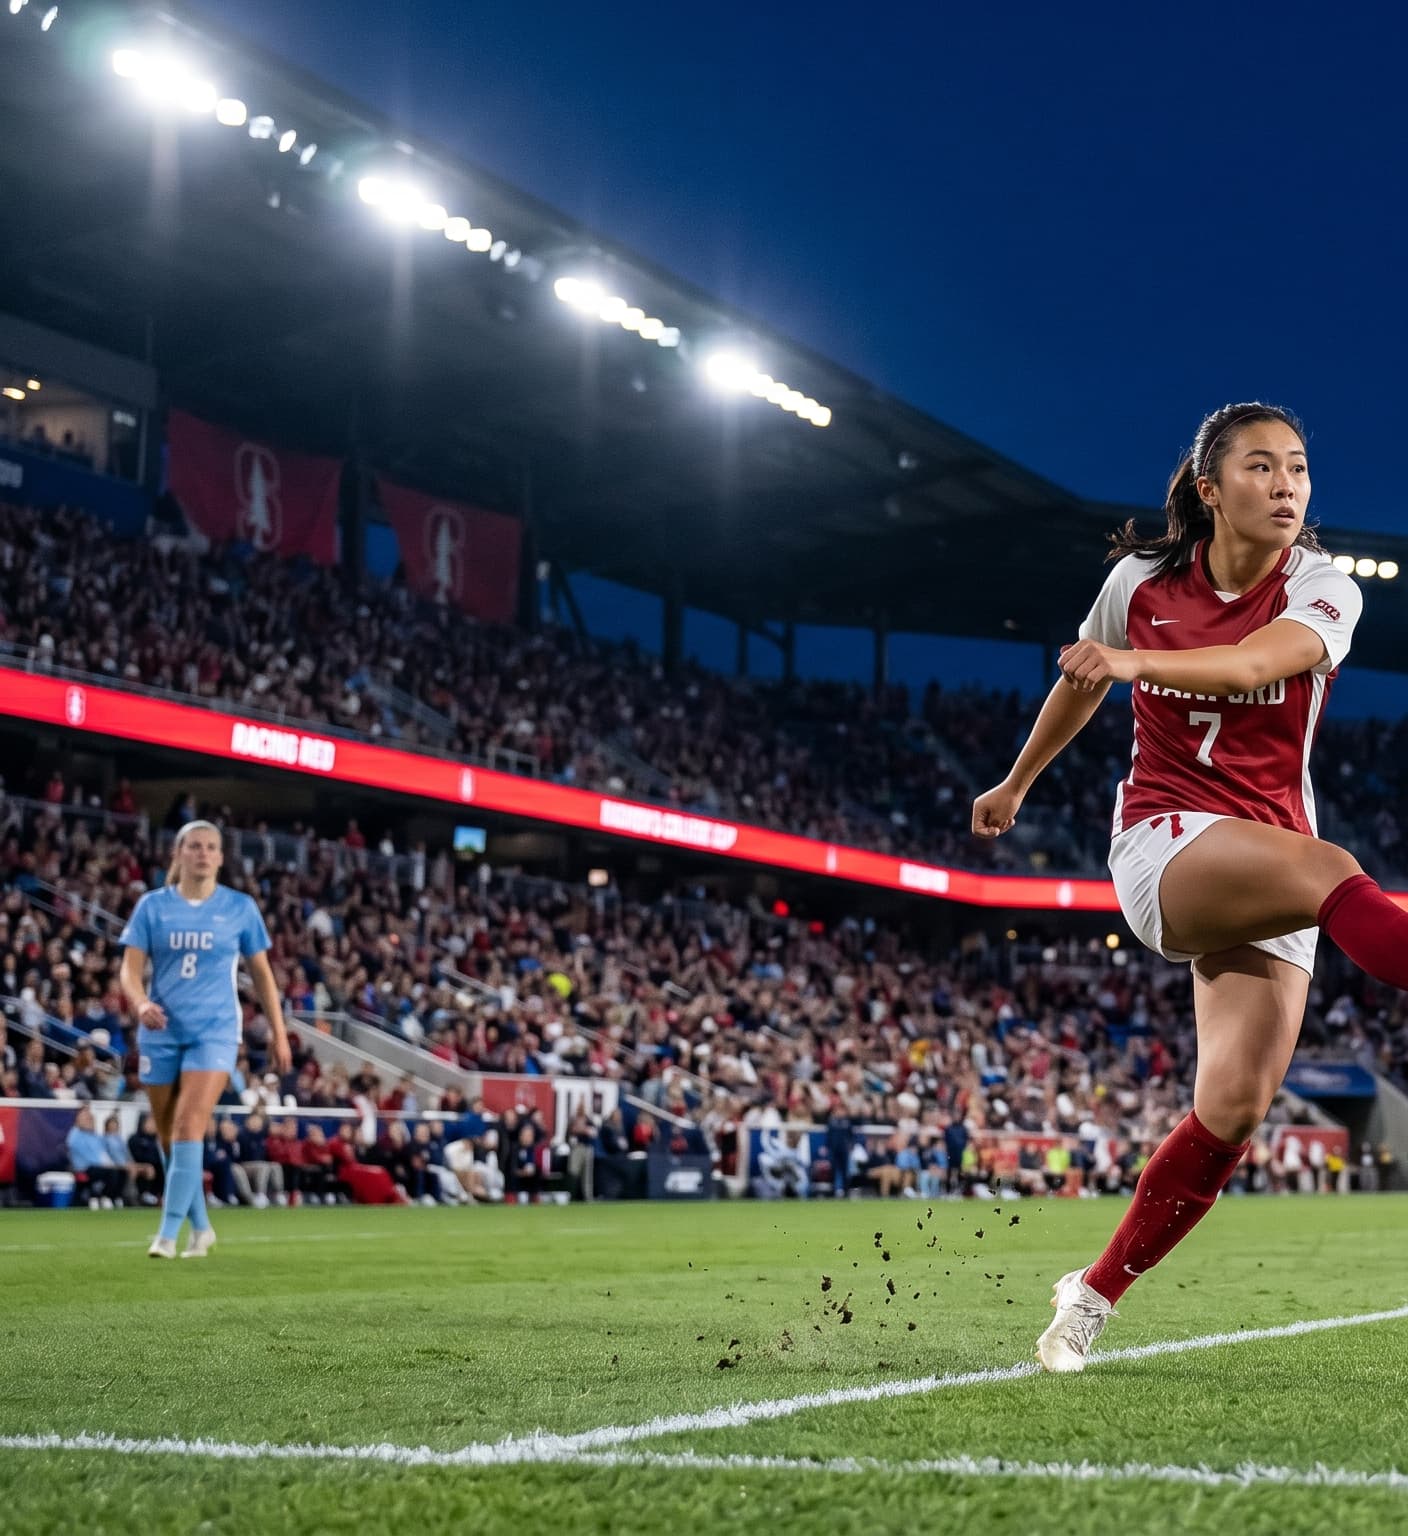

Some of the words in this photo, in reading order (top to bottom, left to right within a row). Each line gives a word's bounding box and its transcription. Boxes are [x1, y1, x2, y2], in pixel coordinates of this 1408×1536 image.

[1189, 710, 1221, 768] 7
[169, 931, 214, 950] UNC
[181, 952, 198, 979] 8
